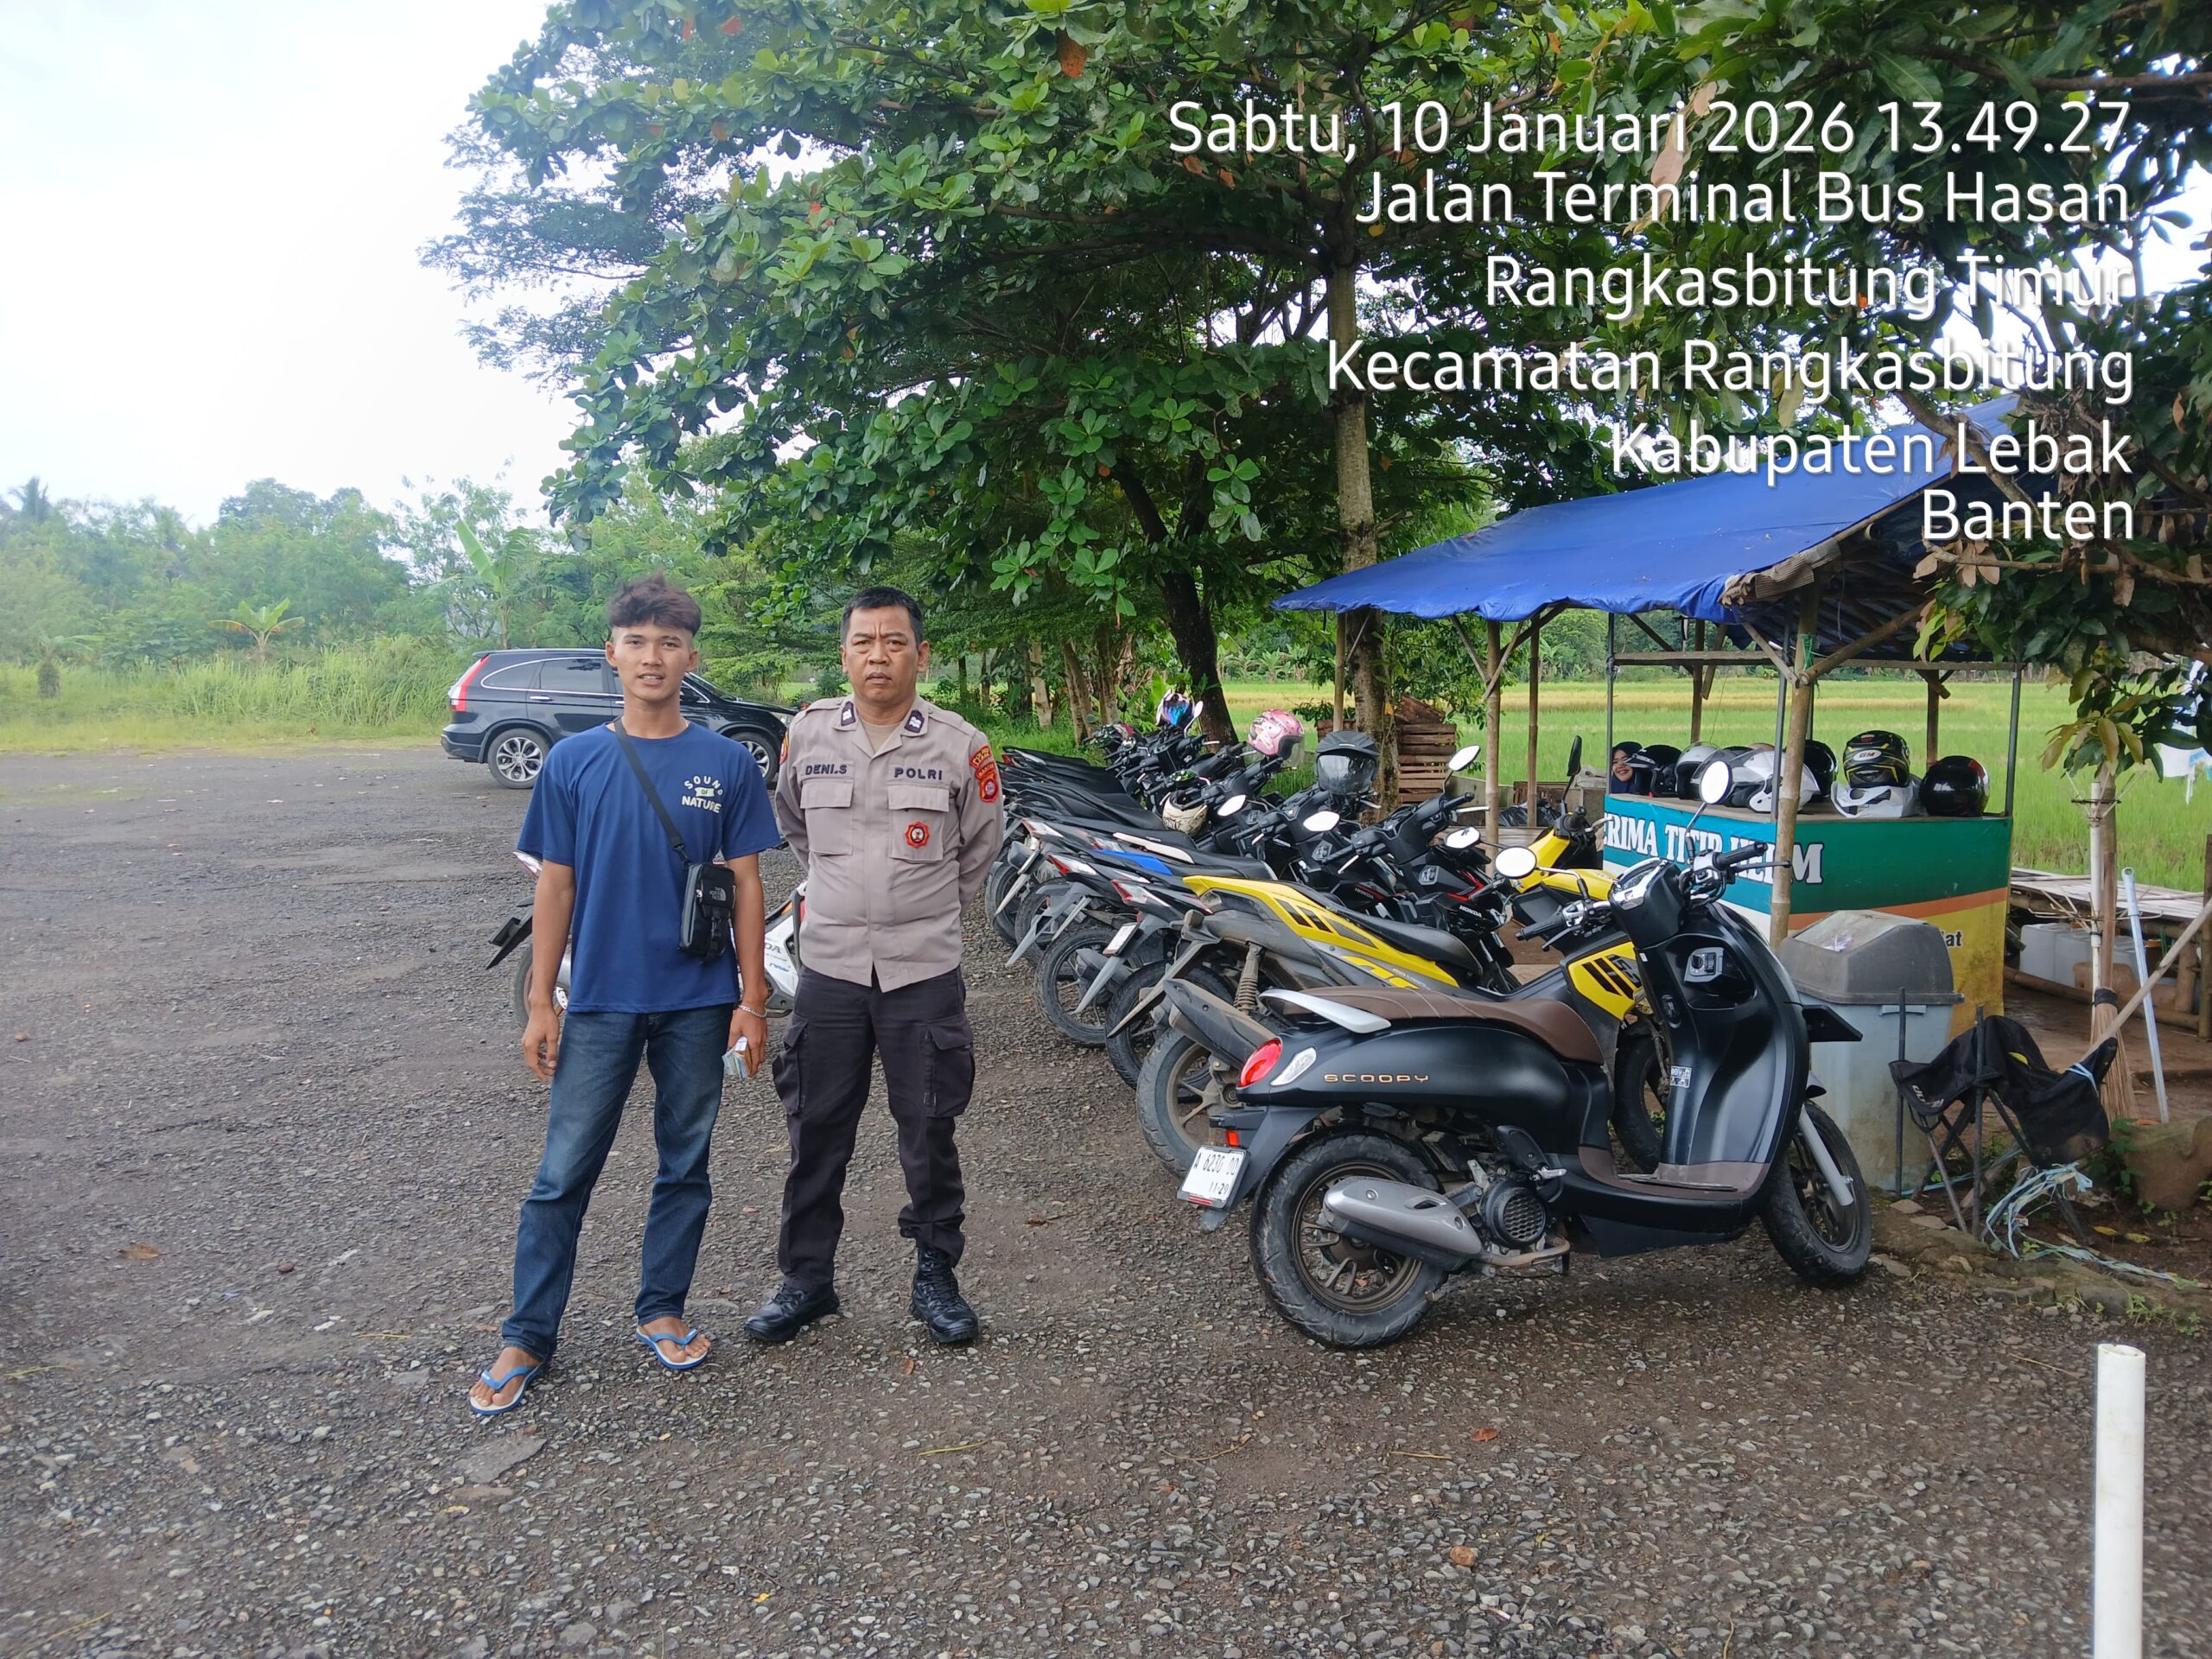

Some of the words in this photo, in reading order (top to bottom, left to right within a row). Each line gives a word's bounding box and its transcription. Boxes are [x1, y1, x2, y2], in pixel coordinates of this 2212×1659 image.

[804, 763, 849, 776] DENI.S
[893, 766, 944, 781] POLRI
[683, 775, 723, 796] SOUND
[681, 795, 722, 814] NATURE
[1324, 1073, 1430, 1084] SCOOPY
